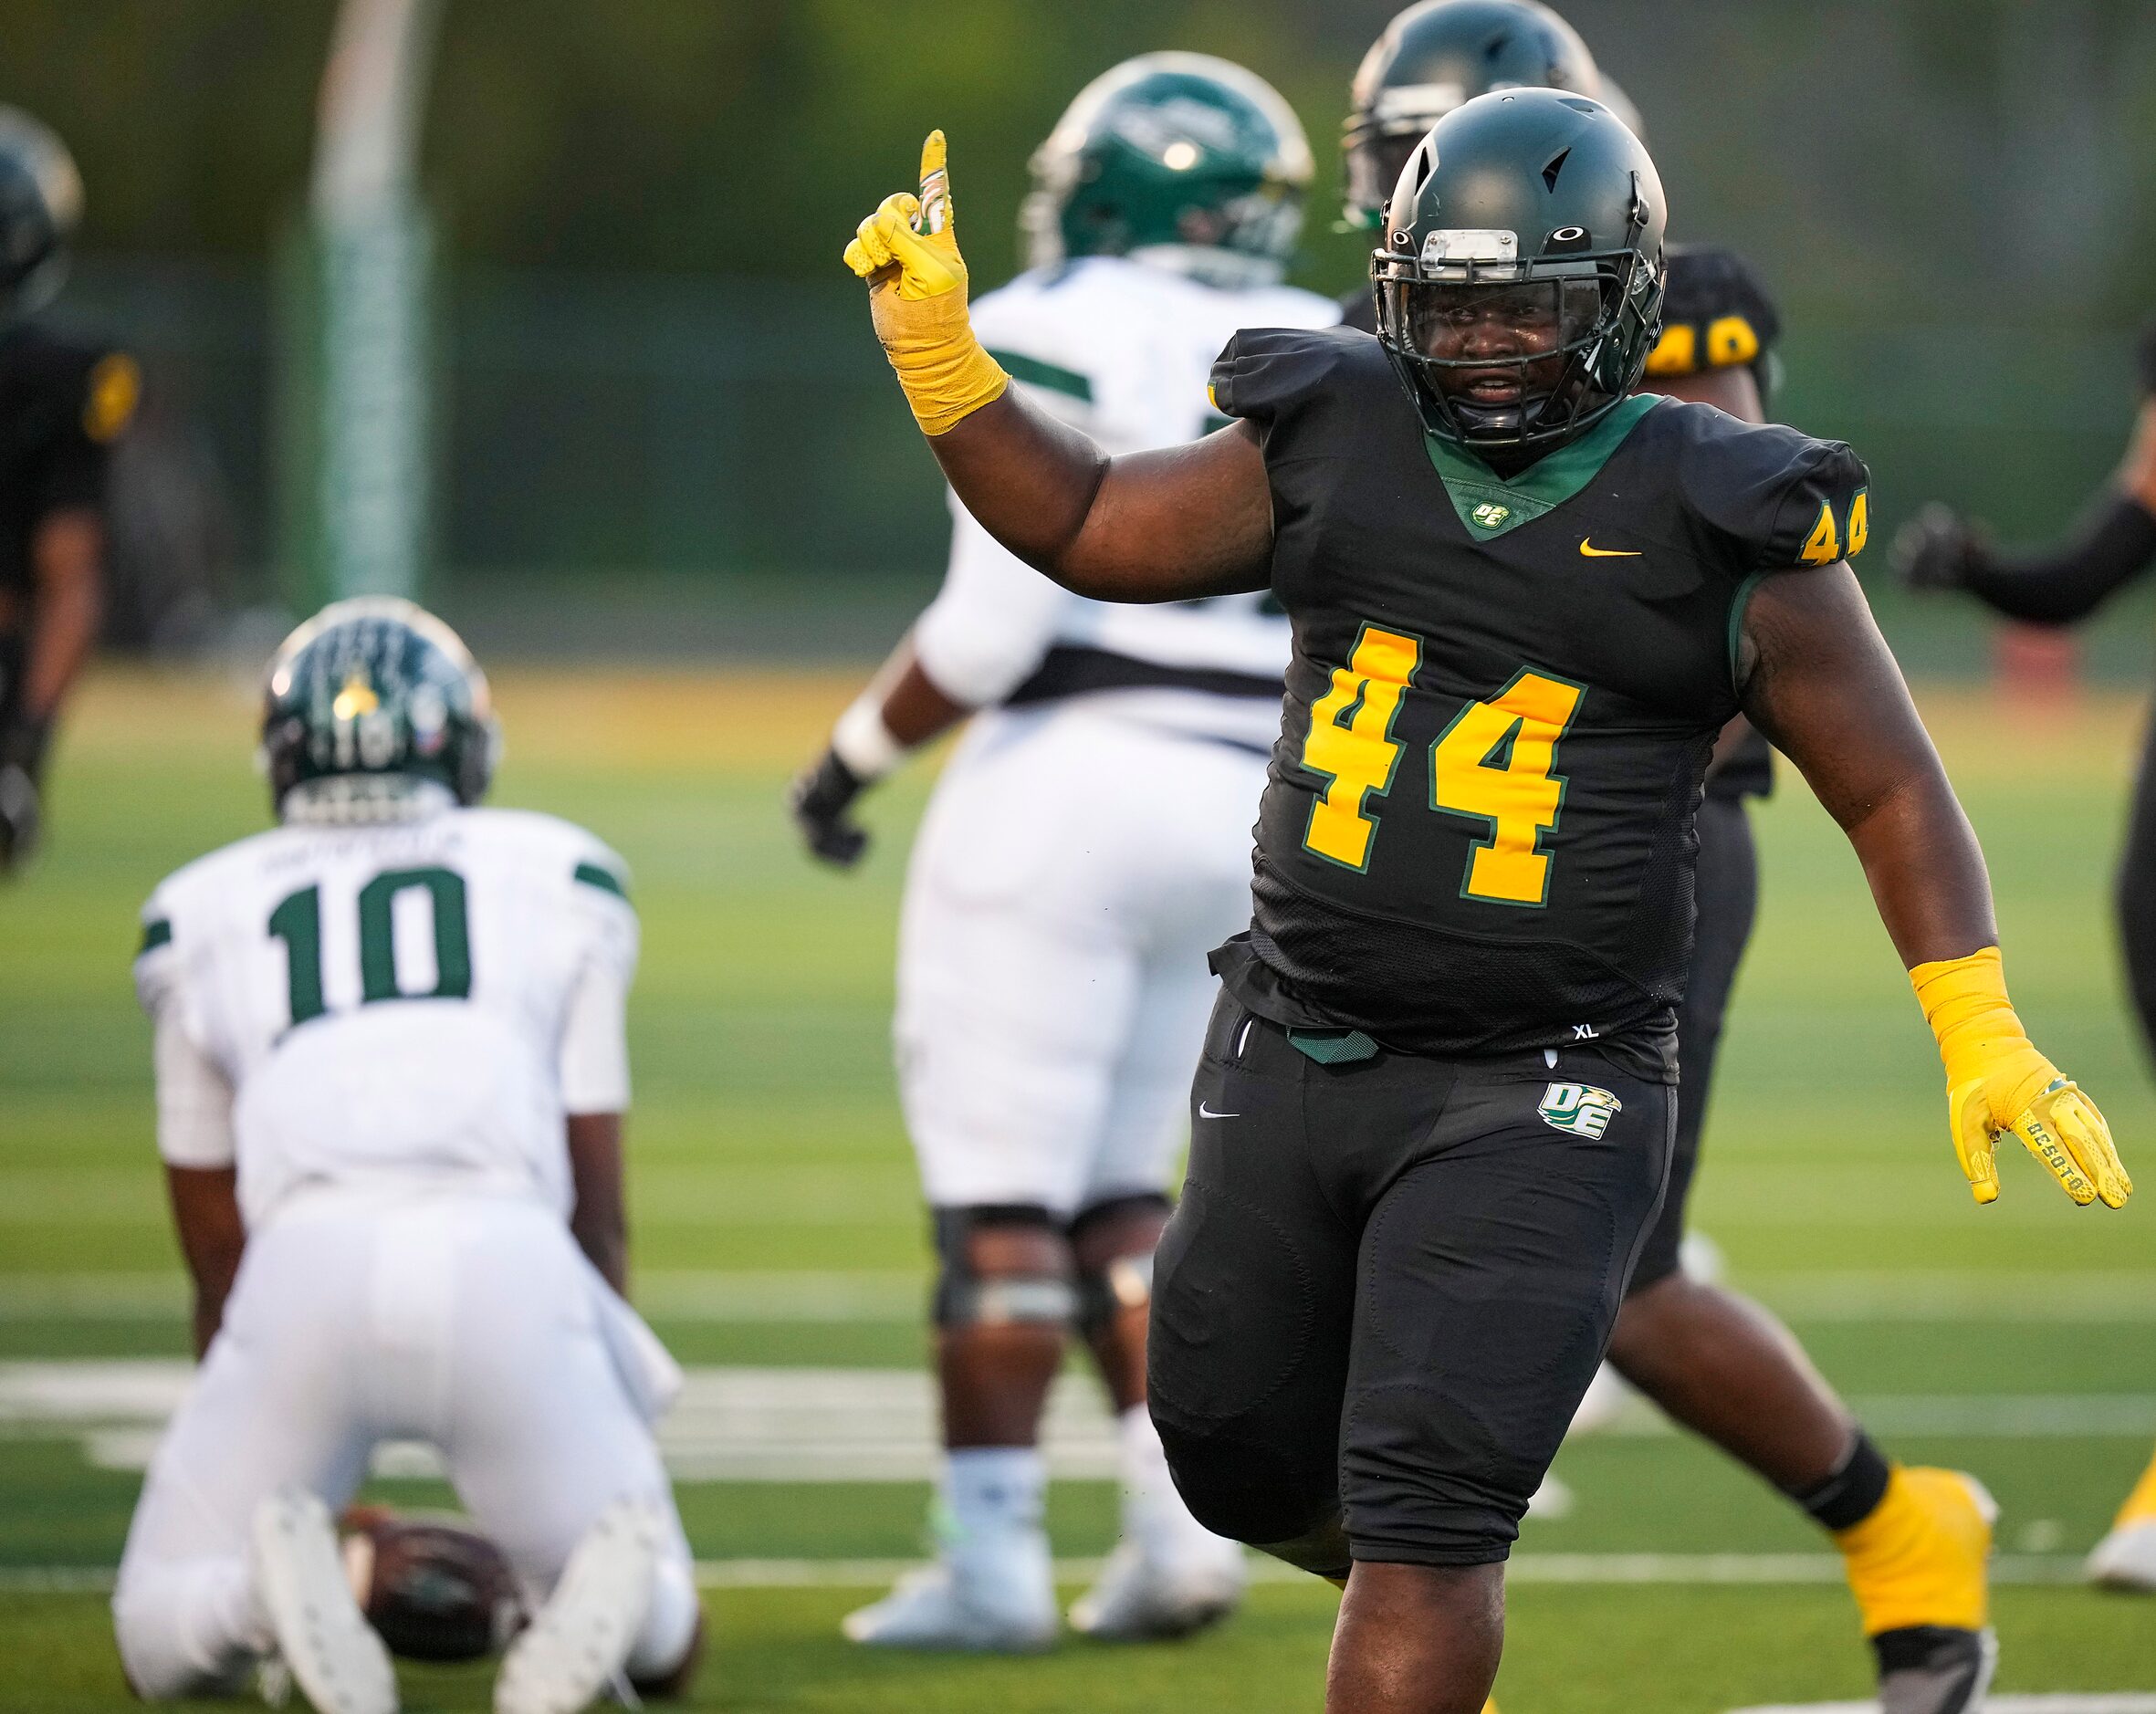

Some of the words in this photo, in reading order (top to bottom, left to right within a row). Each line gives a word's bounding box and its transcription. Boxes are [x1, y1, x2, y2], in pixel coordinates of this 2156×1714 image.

[1795, 486, 1869, 566] 44
[1299, 620, 1589, 909] 44
[268, 864, 471, 1024] 10
[1572, 1023, 1600, 1040] XL
[2026, 1123, 2084, 1191] DESOTO
